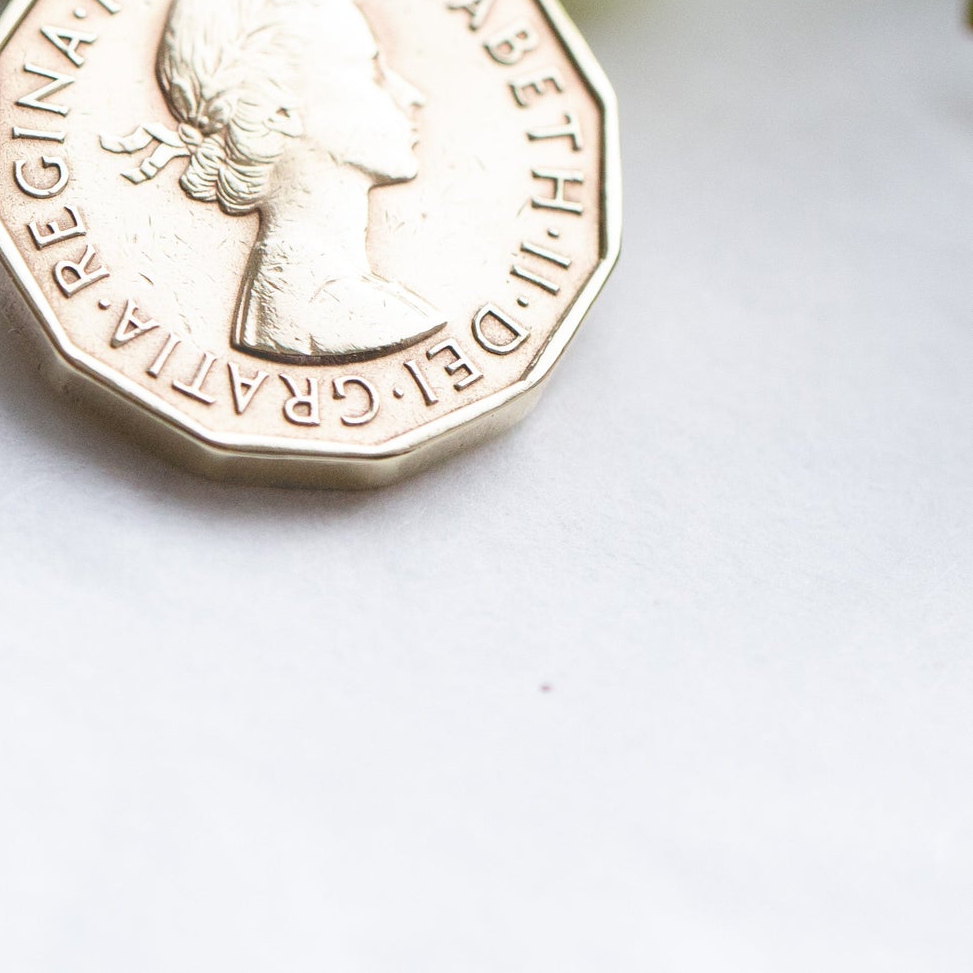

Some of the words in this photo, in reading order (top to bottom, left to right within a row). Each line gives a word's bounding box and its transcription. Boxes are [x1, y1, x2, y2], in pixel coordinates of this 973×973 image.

[11, 26, 109, 298] REGINA
[510, 241, 571, 295] II
[110, 298, 381, 427] GRATIA
[404, 303, 530, 406] DEI
